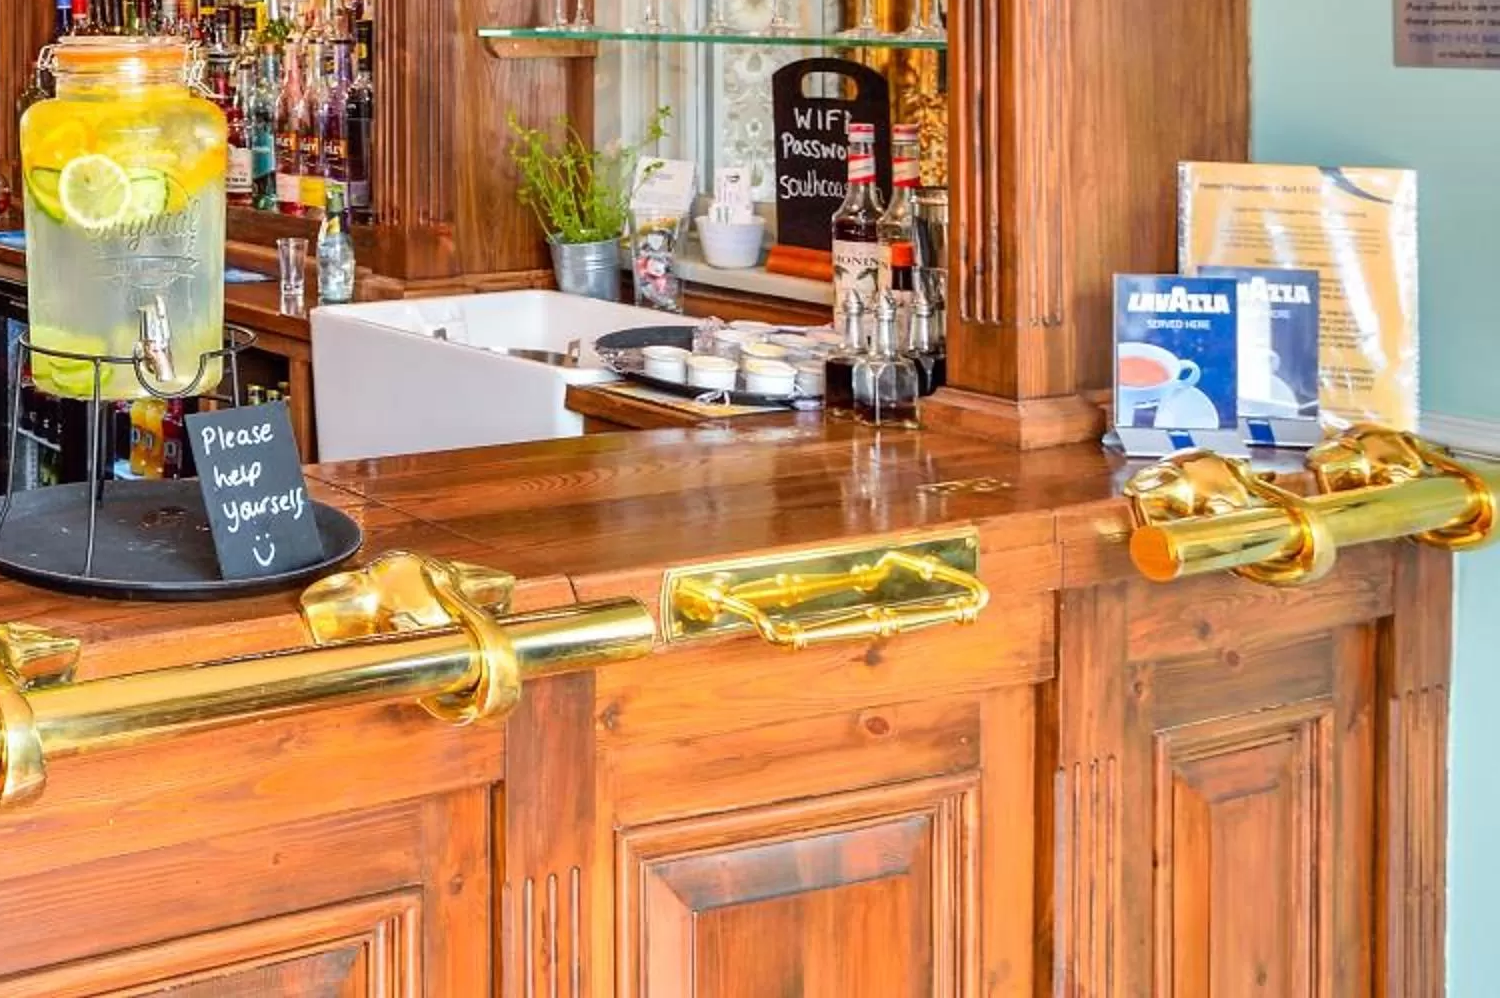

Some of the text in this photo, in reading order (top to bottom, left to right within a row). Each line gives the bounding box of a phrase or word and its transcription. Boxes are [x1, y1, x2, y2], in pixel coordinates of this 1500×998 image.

[781, 131, 847, 160] Passwo
[1127, 286, 1230, 314] LAVAZZA
[201, 423, 274, 455] Please
[213, 461, 262, 489] help
